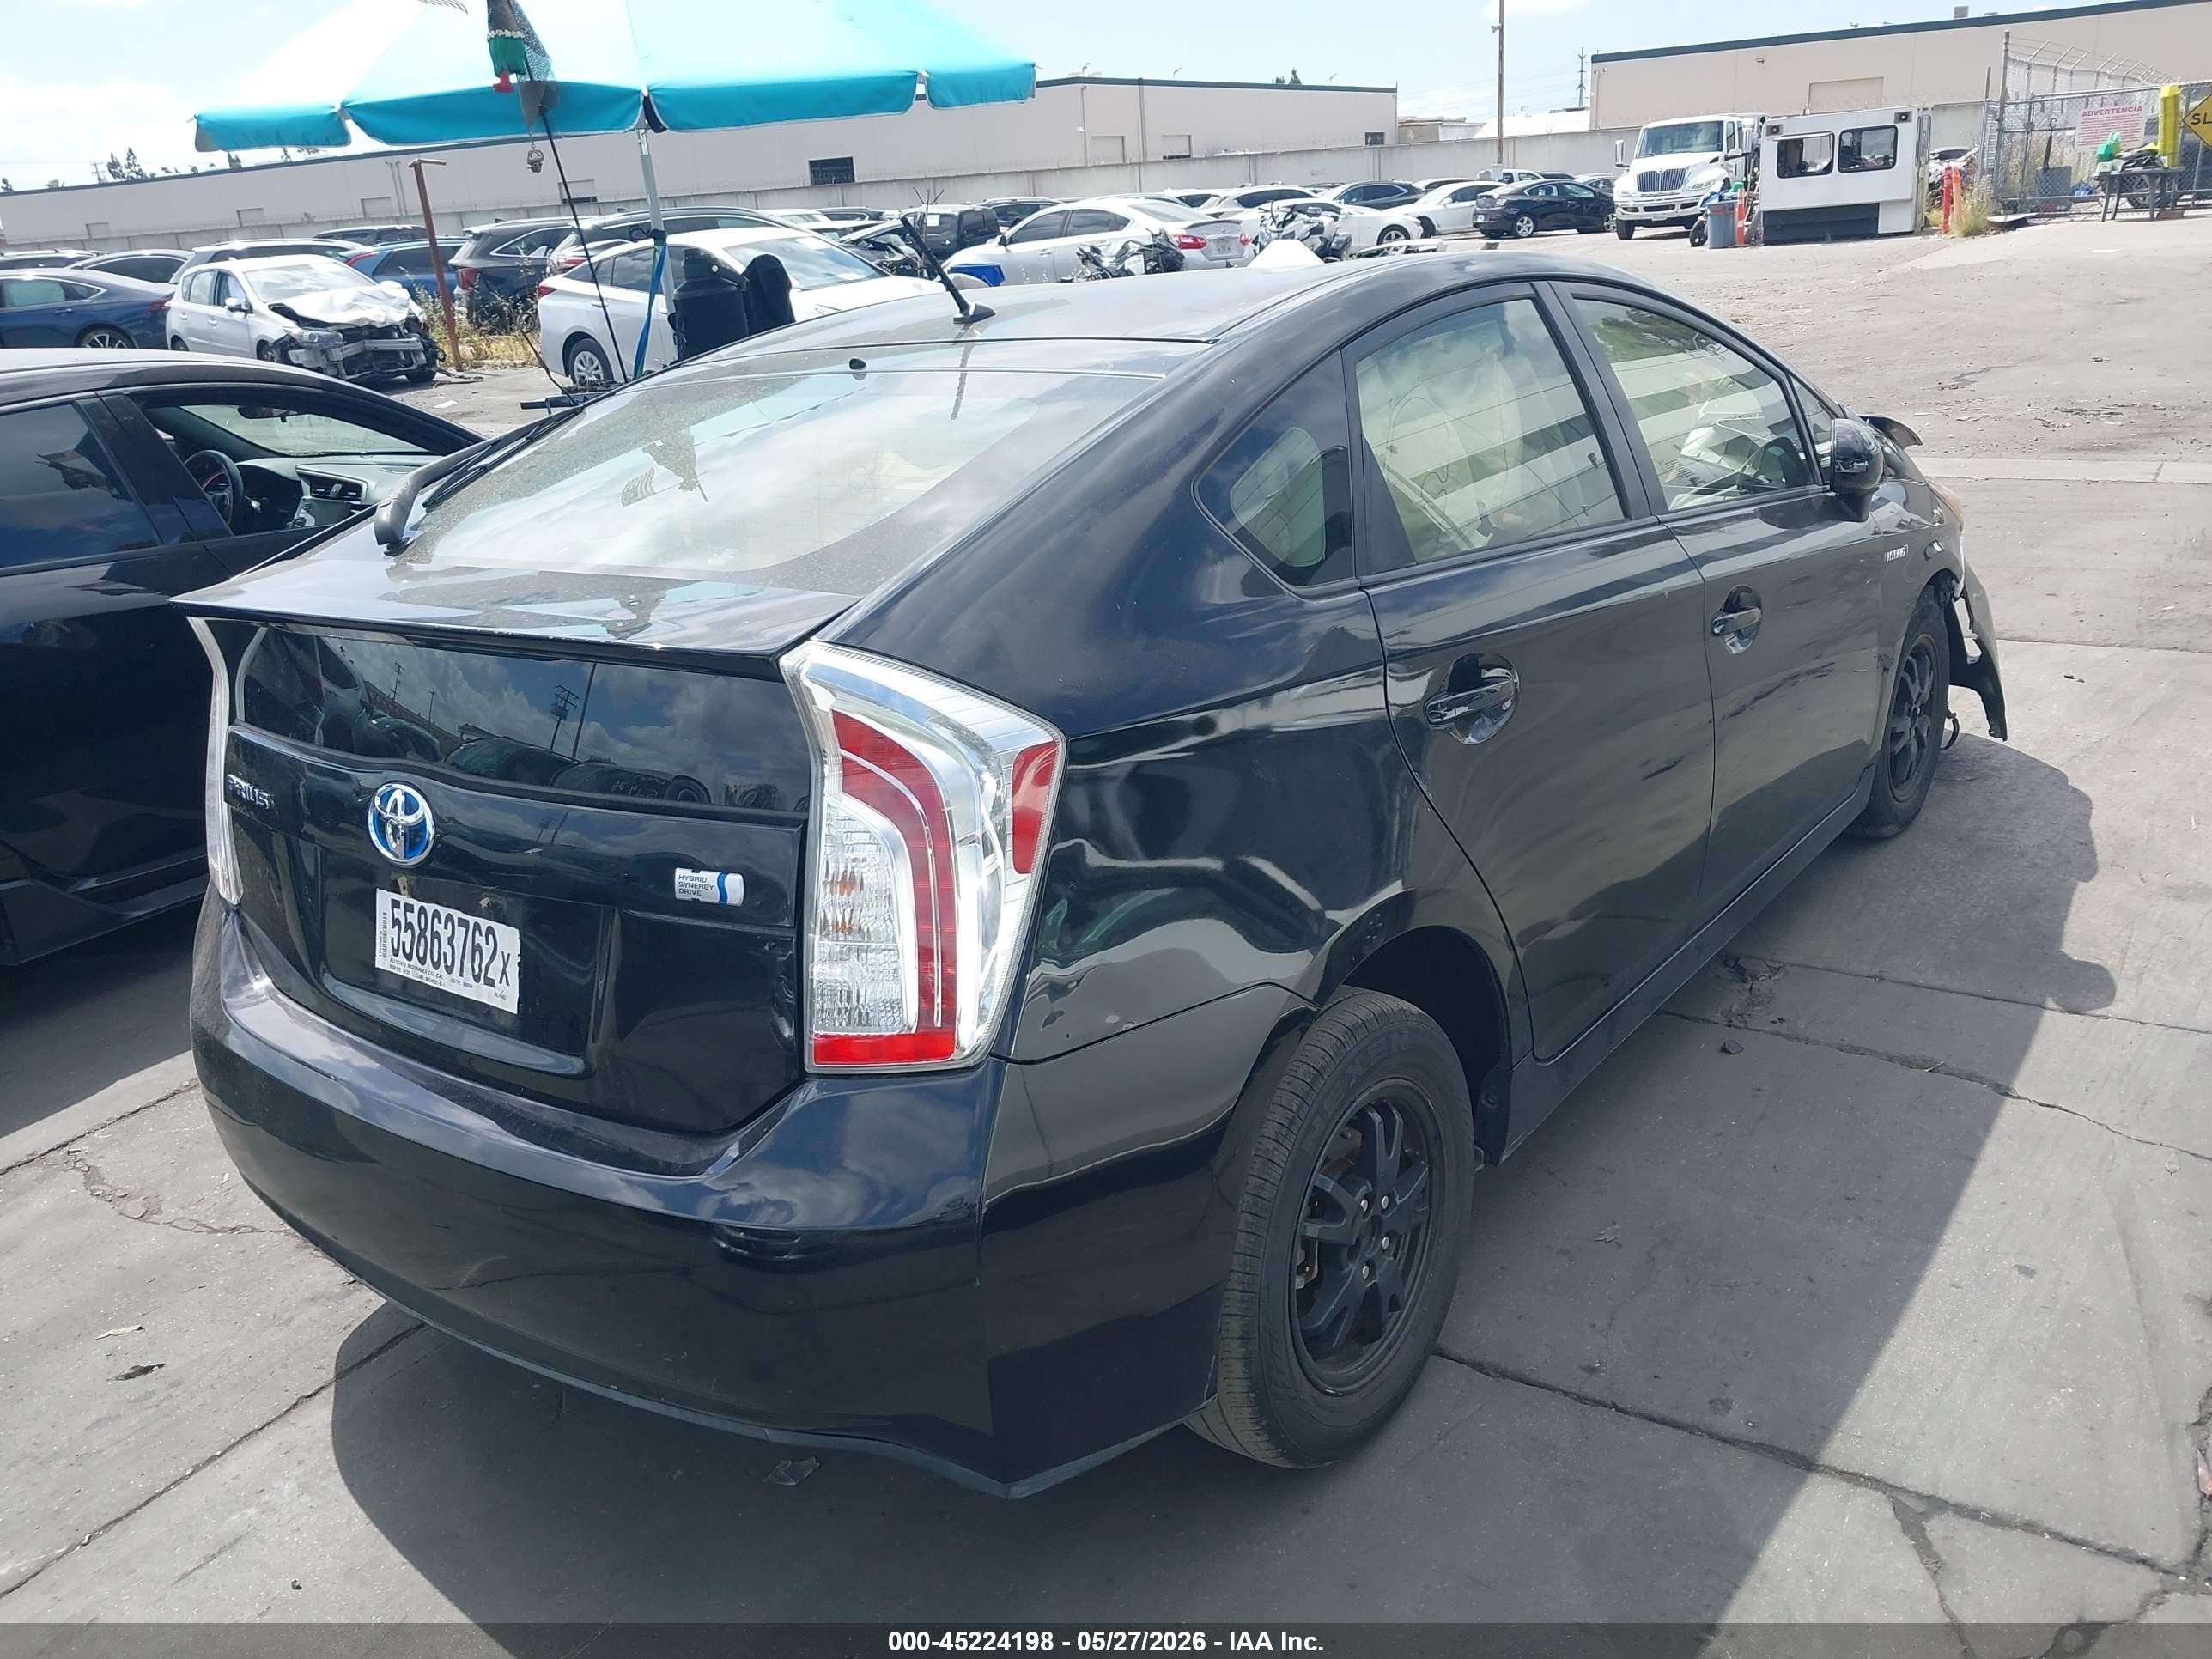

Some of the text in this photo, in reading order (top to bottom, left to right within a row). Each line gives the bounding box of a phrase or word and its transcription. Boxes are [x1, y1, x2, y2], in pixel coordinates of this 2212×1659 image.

[2081, 106, 2142, 117] ADVERTENCIA
[228, 774, 271, 809] PRIUS
[678, 874, 707, 883] HYBRID
[678, 881, 714, 890] SYNERGY
